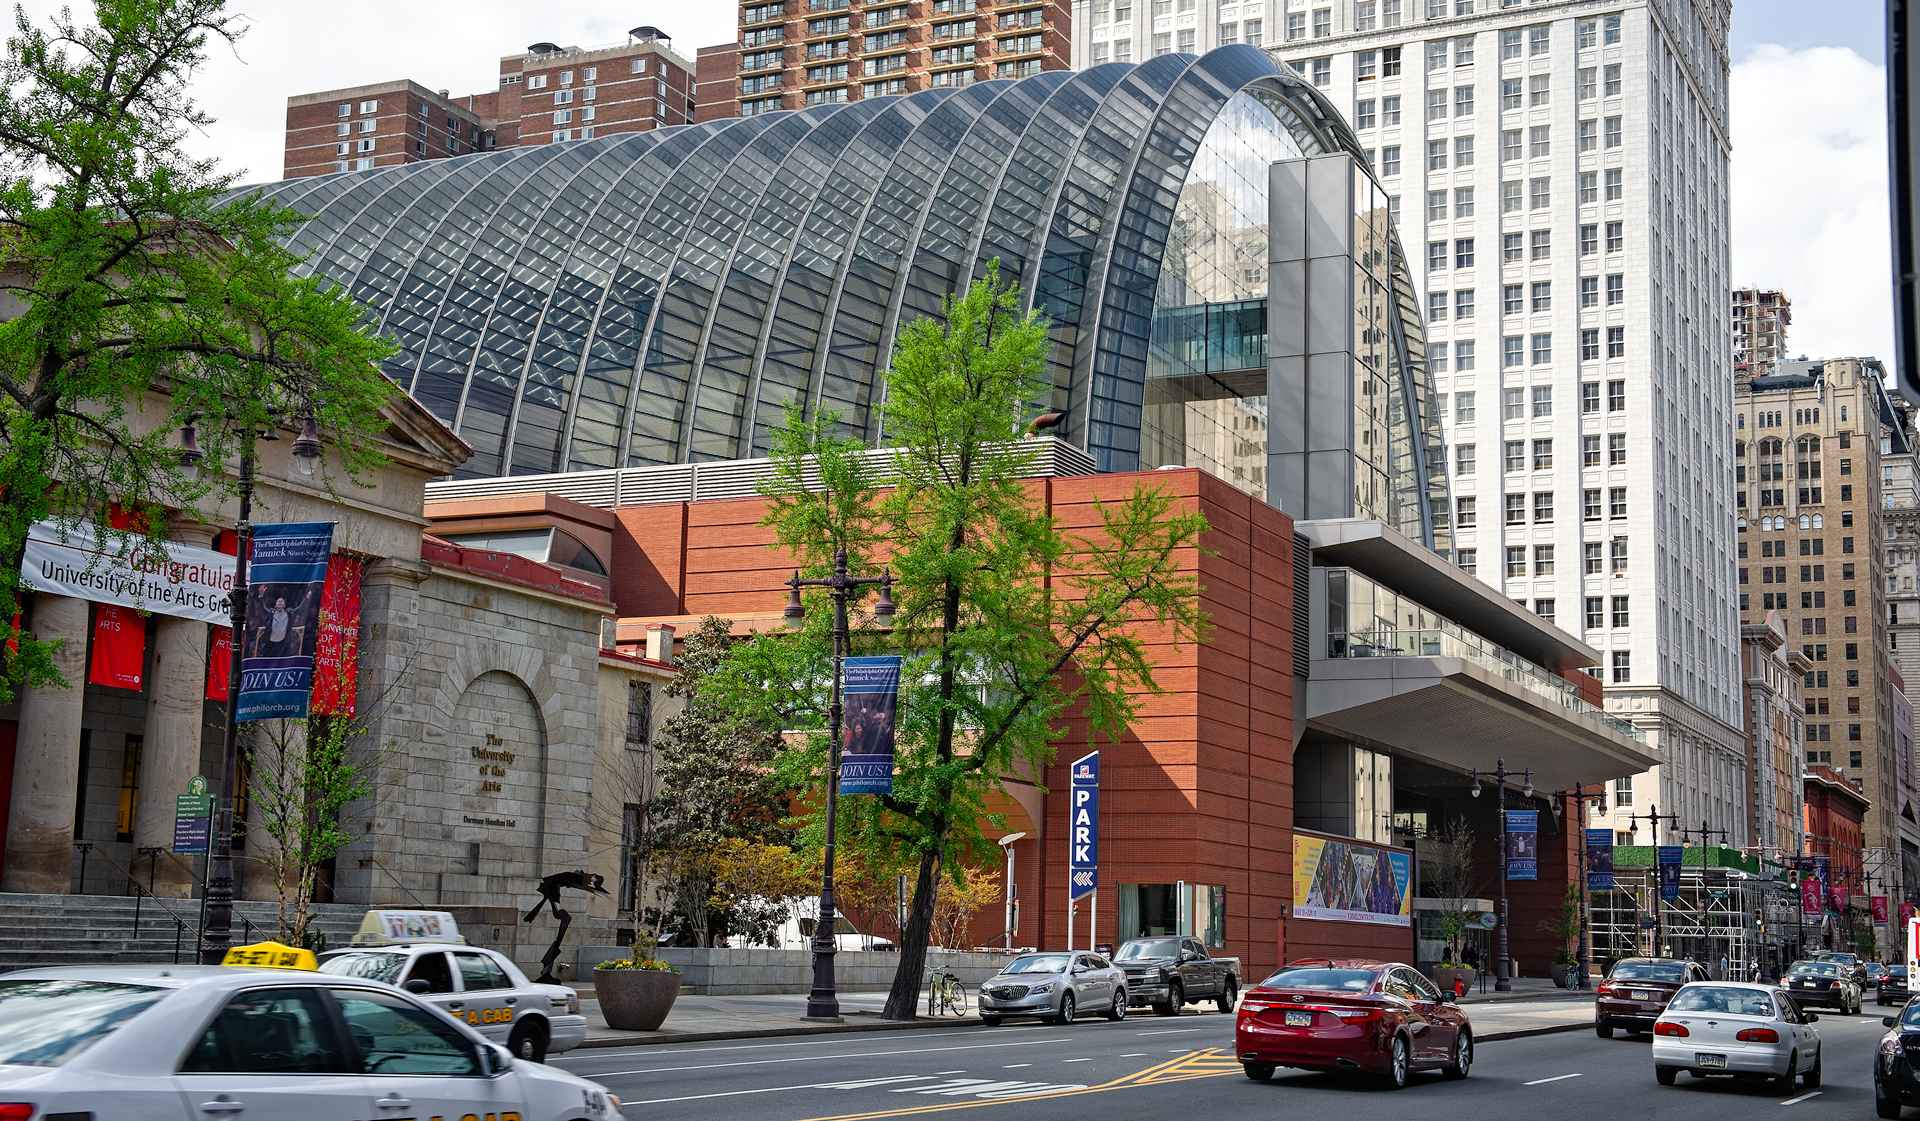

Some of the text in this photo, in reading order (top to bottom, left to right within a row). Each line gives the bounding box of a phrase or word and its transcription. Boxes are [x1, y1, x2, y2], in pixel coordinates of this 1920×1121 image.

[254, 547, 286, 558] Yannick
[42, 560, 124, 597] University
[128, 577, 144, 598] of
[148, 581, 171, 603] the
[175, 587, 204, 609] Arts
[321, 634, 334, 643] OF
[321, 645, 337, 656] THE
[320, 657, 341, 669] ARTS
[241, 671, 303, 692] JOIN US!
[845, 673, 872, 681] Yannick
[486, 734, 503, 746] The
[472, 746, 515, 765] University
[480, 765, 505, 777] of the
[841, 765, 889, 778] JOIN US!
[481, 779, 502, 792] Arts
[1075, 790, 1091, 862] PARK
[466, 1009, 480, 1024] A
[481, 1007, 513, 1025] CAB
